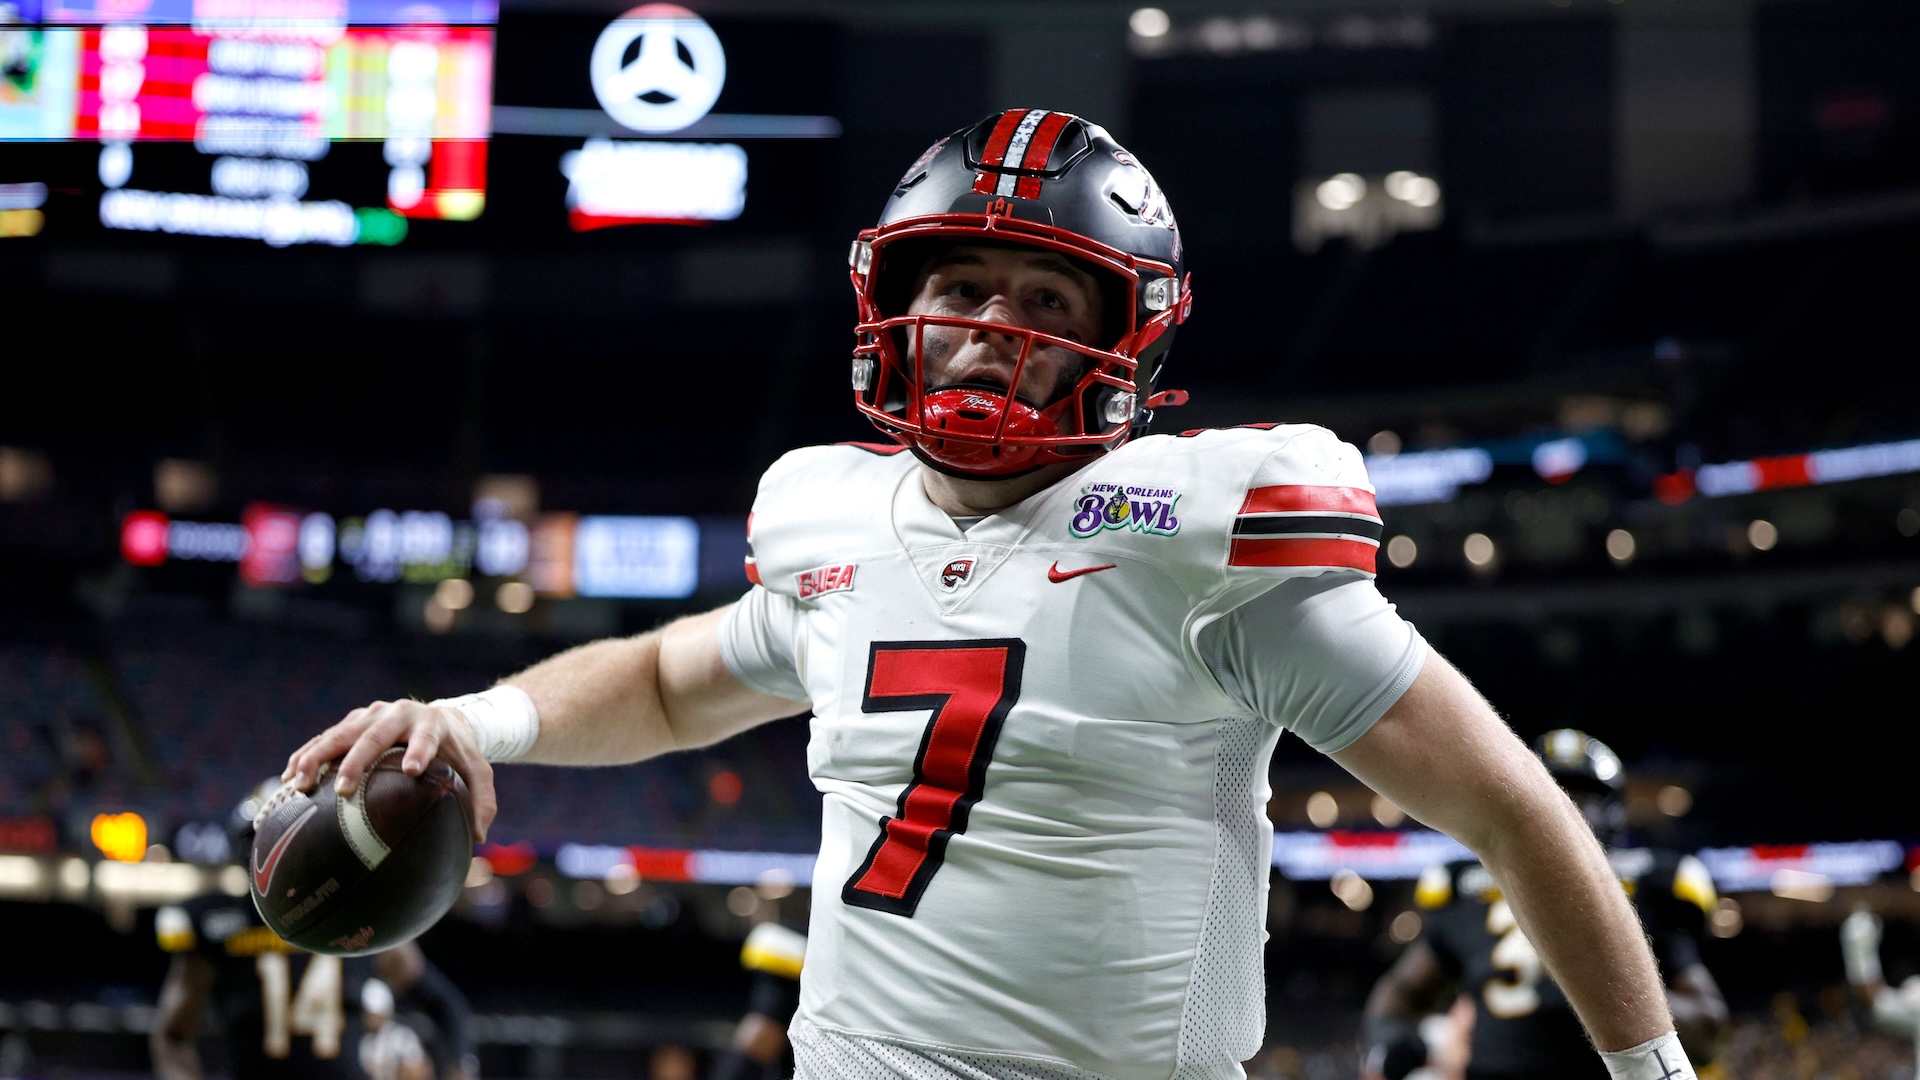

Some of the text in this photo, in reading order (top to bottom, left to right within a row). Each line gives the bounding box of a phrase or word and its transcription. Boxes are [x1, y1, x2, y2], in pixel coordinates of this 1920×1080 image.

[961, 394, 996, 408] Tops
[1091, 484, 1174, 499] NEW ORLEANS
[1072, 494, 1178, 533] BOWL
[841, 638, 1026, 918] 7
[256, 952, 346, 1059] 14
